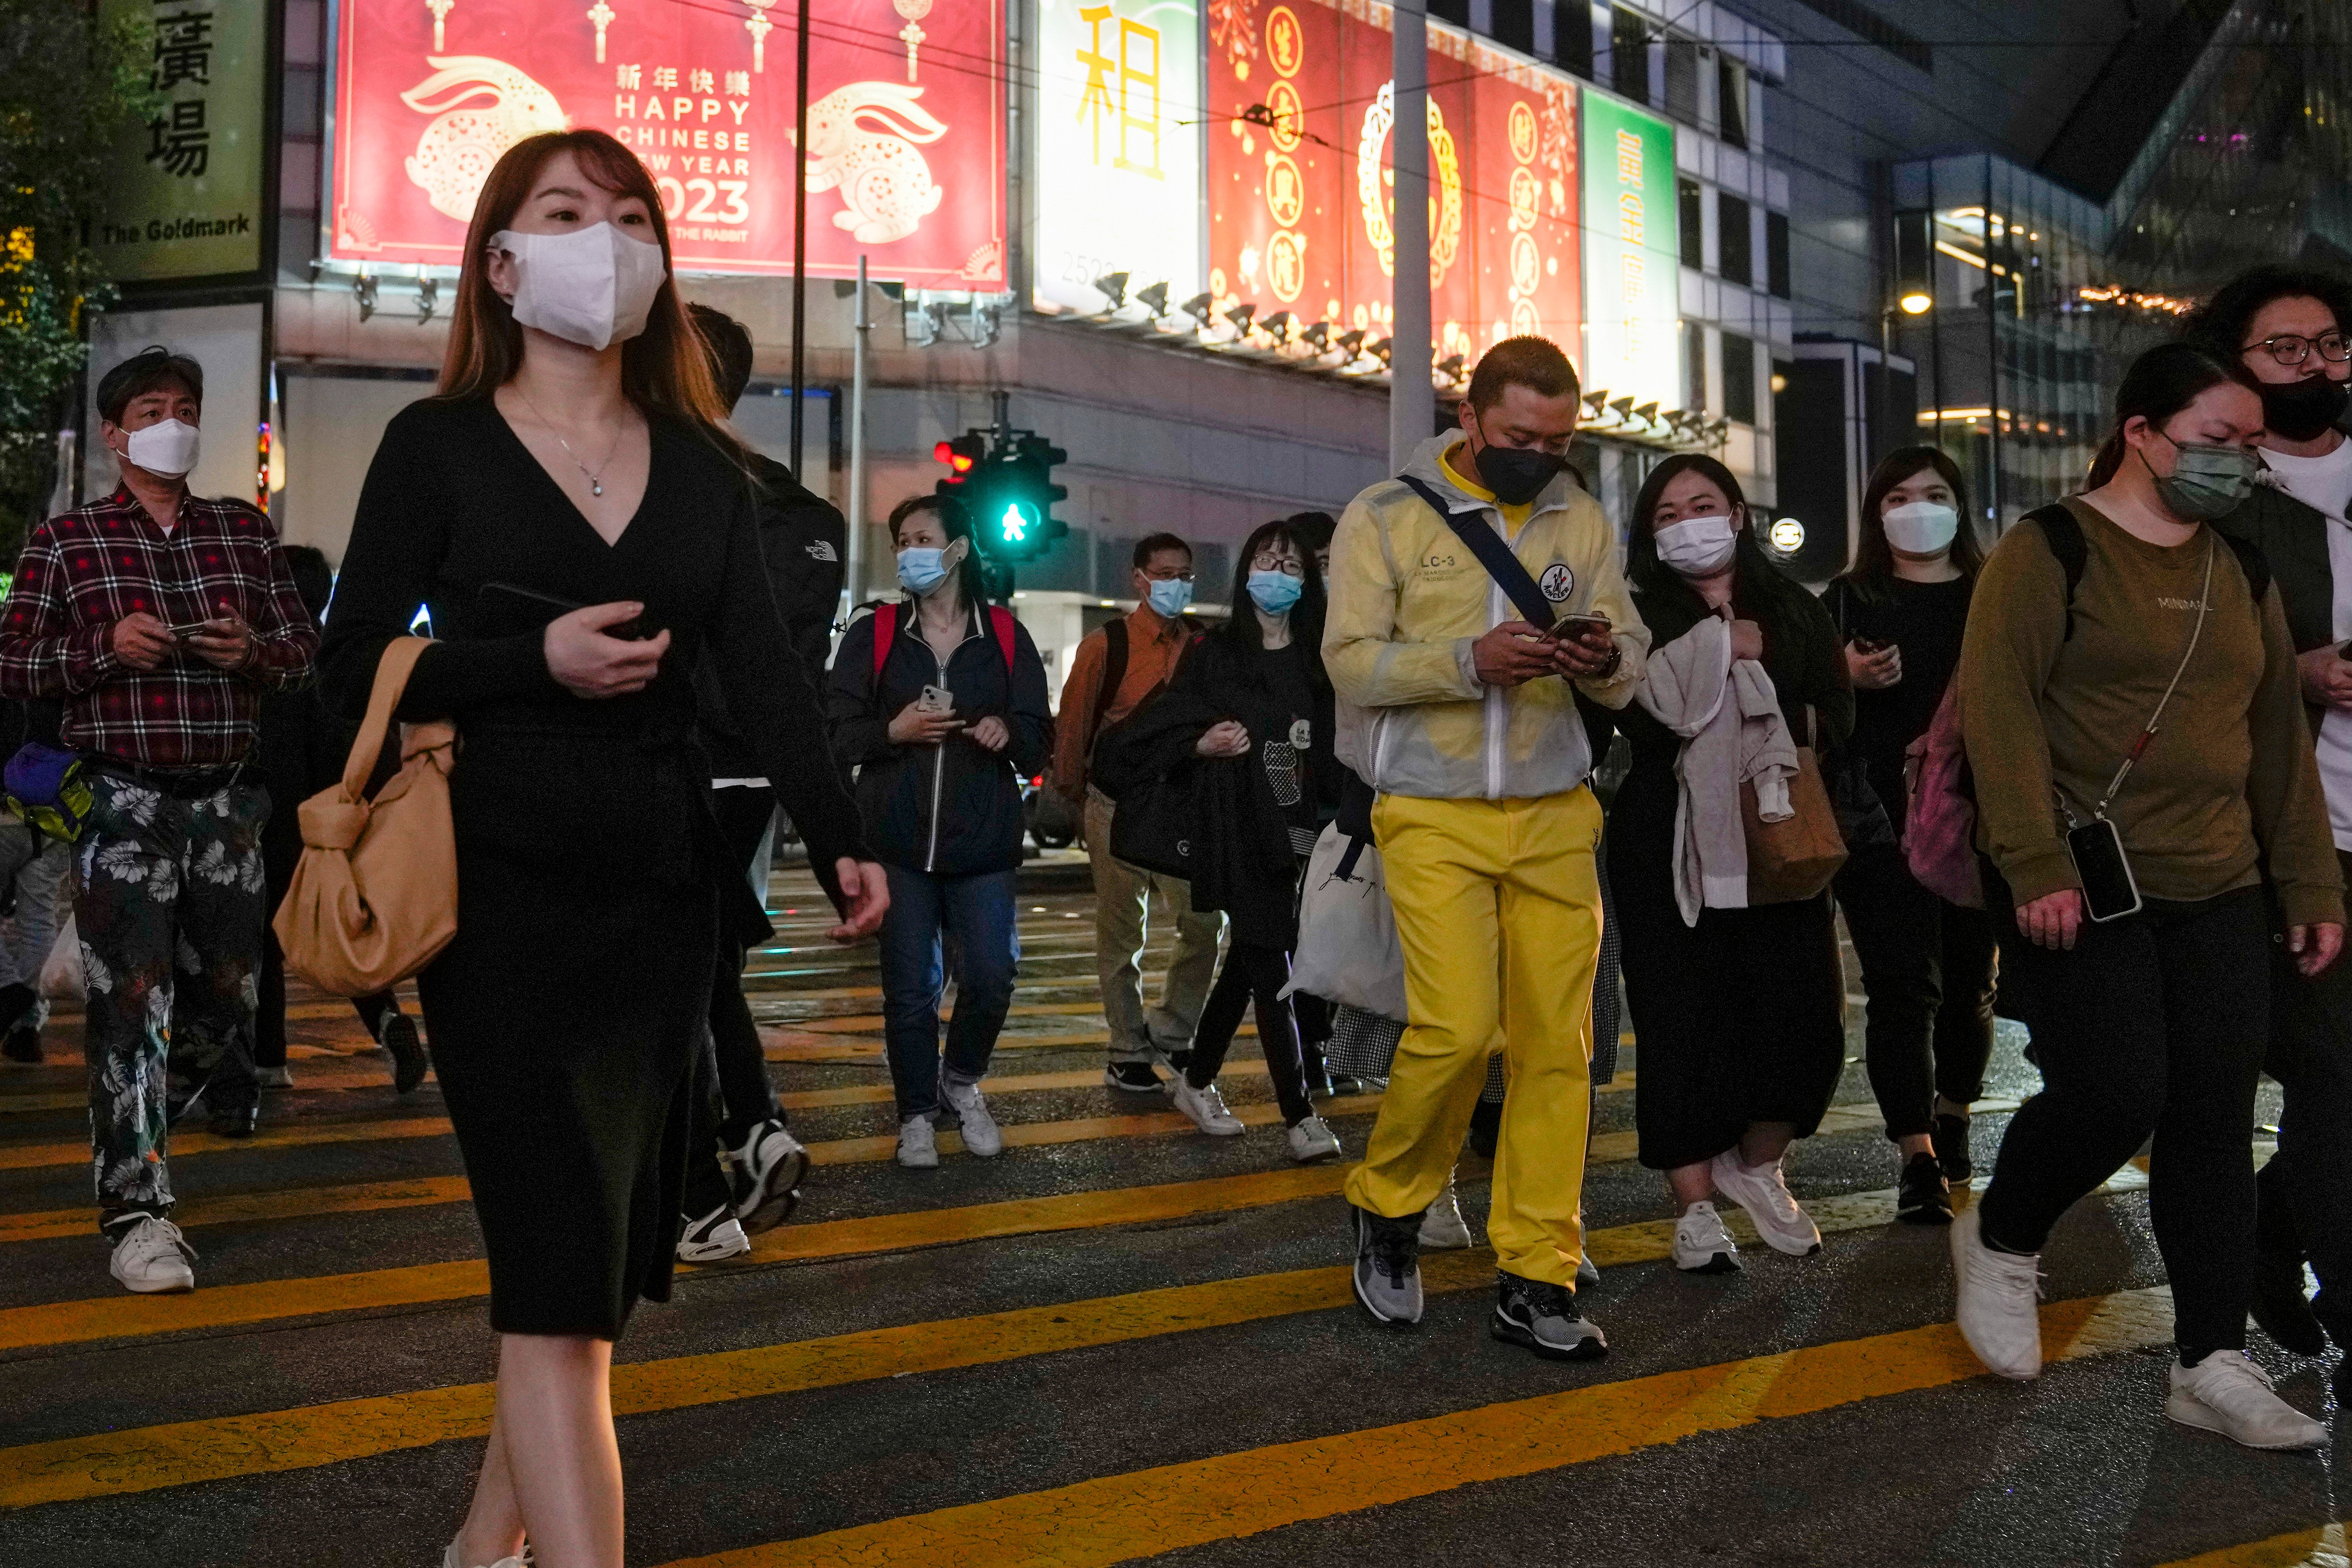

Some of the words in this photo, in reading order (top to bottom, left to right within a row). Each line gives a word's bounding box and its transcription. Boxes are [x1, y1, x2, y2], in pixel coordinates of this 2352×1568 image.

[146, 0, 213, 178] 廣場
[616, 64, 750, 96] 新年快樂
[1076, 5, 1165, 181] 租
[616, 94, 749, 125] HAPPY
[616, 127, 749, 152] CHINESE
[681, 156, 749, 176] YEAR
[656, 176, 749, 224] 023
[102, 224, 139, 245] The
[147, 213, 249, 240] Goldmark
[673, 226, 701, 241] THE
[1421, 555, 1455, 568] LC-3
[1543, 584, 1569, 599] MONCLER
